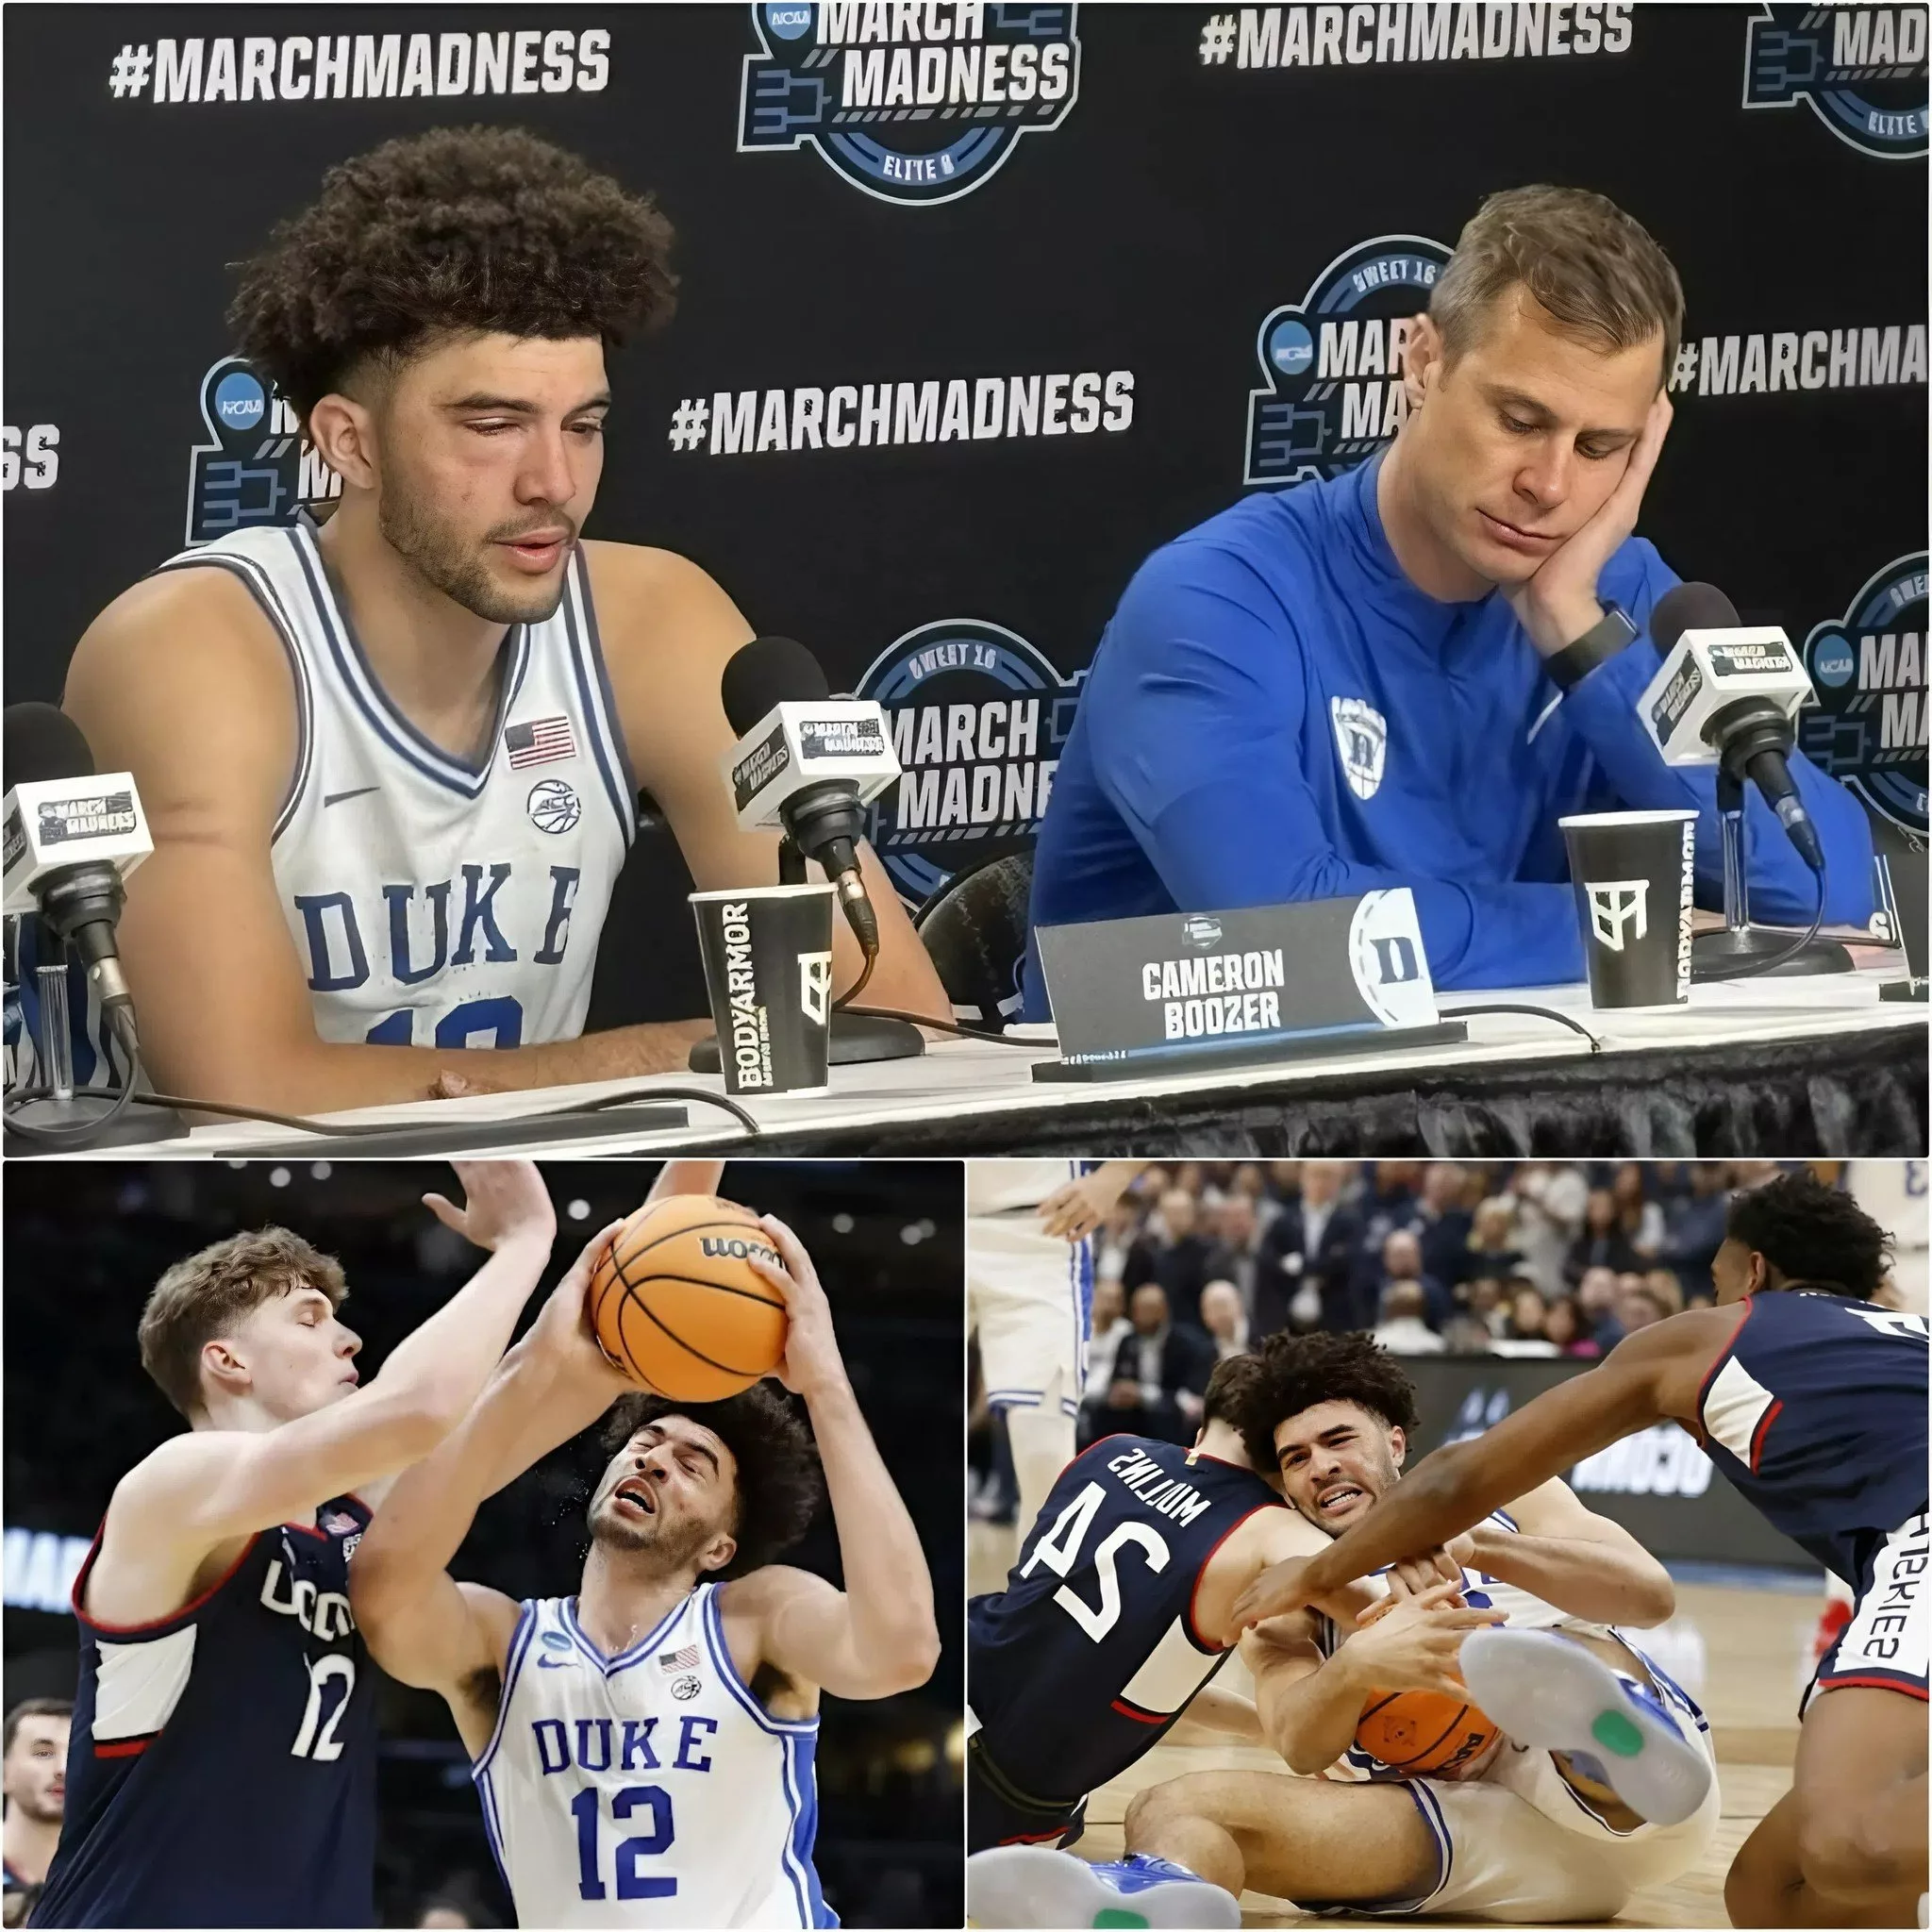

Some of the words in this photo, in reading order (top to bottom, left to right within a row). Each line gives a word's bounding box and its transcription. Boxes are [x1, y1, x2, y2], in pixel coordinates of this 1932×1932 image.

[816, 3, 984, 44] MARCH
[1199, 4, 1633, 69] #MARCHMADNESS
[109, 29, 610, 103] #MARCHMADNESS
[841, 42, 1070, 108] MADNESS
[883, 154, 938, 181] ELITE
[668, 371, 1135, 455] #MARCHMADNESS
[893, 699, 1039, 765] MARCH
[294, 863, 580, 991] DUKE
[722, 902, 762, 1089] BODYARMOR
[1142, 949, 1285, 1001] CAMERON
[1165, 991, 1281, 1040] BOOZER
[291, 1652, 356, 1761] 12
[531, 1715, 719, 1775] DUKE
[571, 1785, 678, 1900] 12
